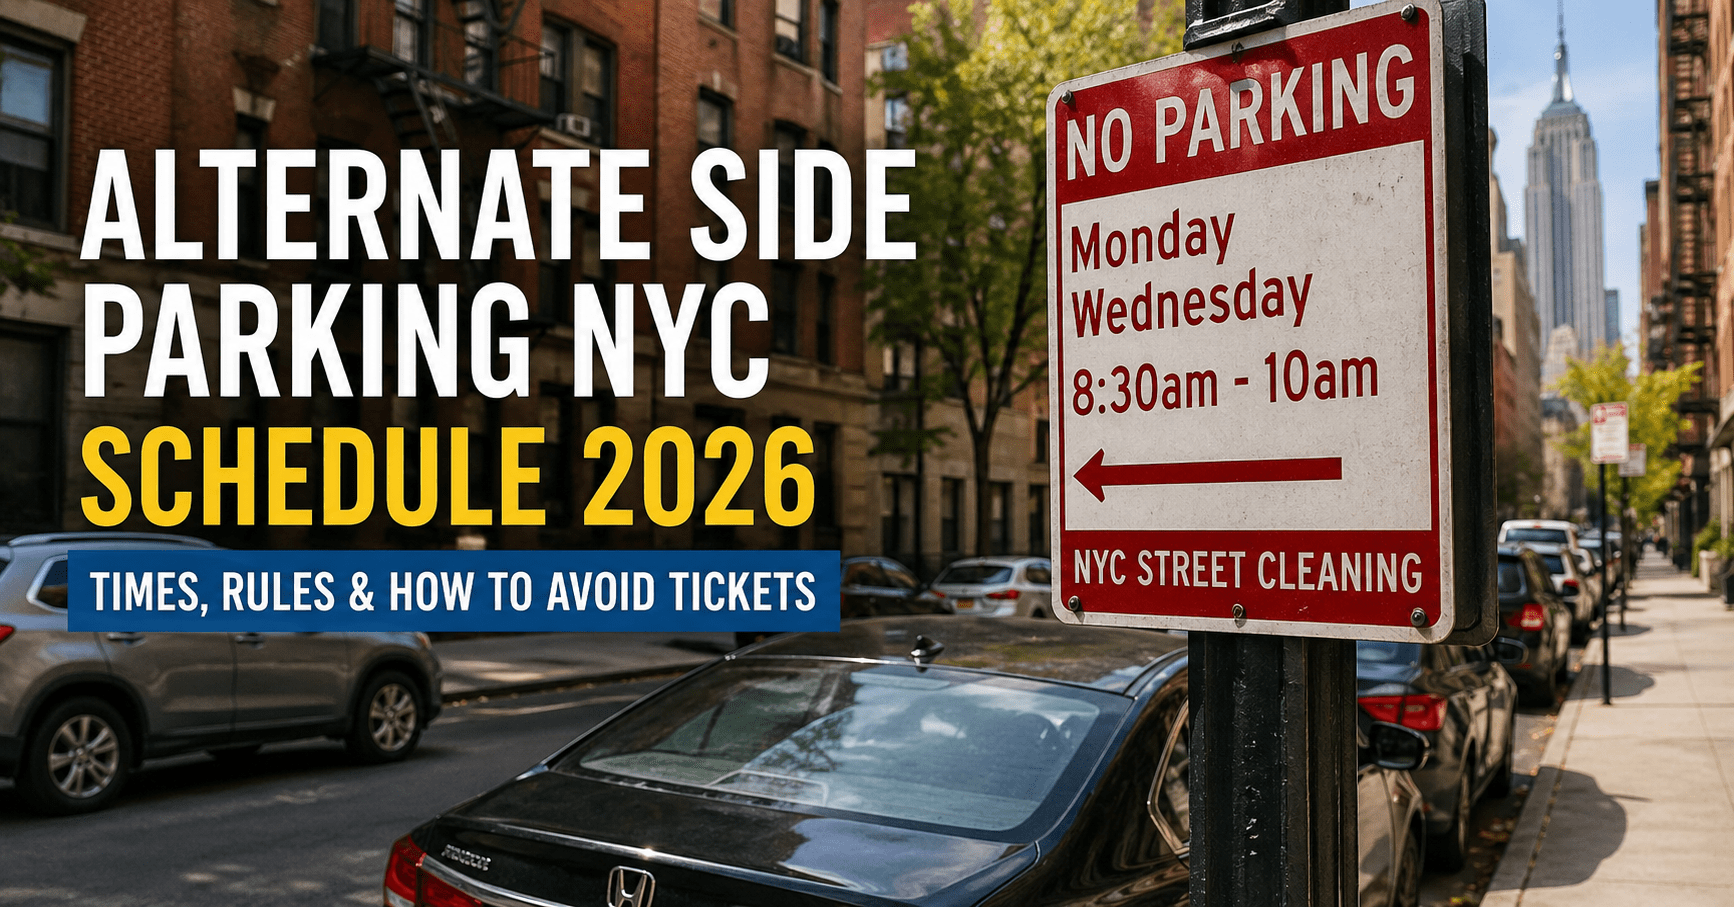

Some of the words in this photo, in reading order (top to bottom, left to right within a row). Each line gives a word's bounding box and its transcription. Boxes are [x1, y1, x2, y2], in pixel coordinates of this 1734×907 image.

[1066, 107, 1132, 182] NO
[1155, 43, 1415, 164] PARKING
[1071, 208, 1235, 273] Monday
[1071, 267, 1313, 338] Wednesday
[1072, 362, 1218, 417] 8:30am
[1264, 349, 1379, 403] 10am
[1073, 548, 1127, 586] NYC
[1137, 549, 1246, 589] STREET
[1257, 551, 1424, 595] CLEANING
